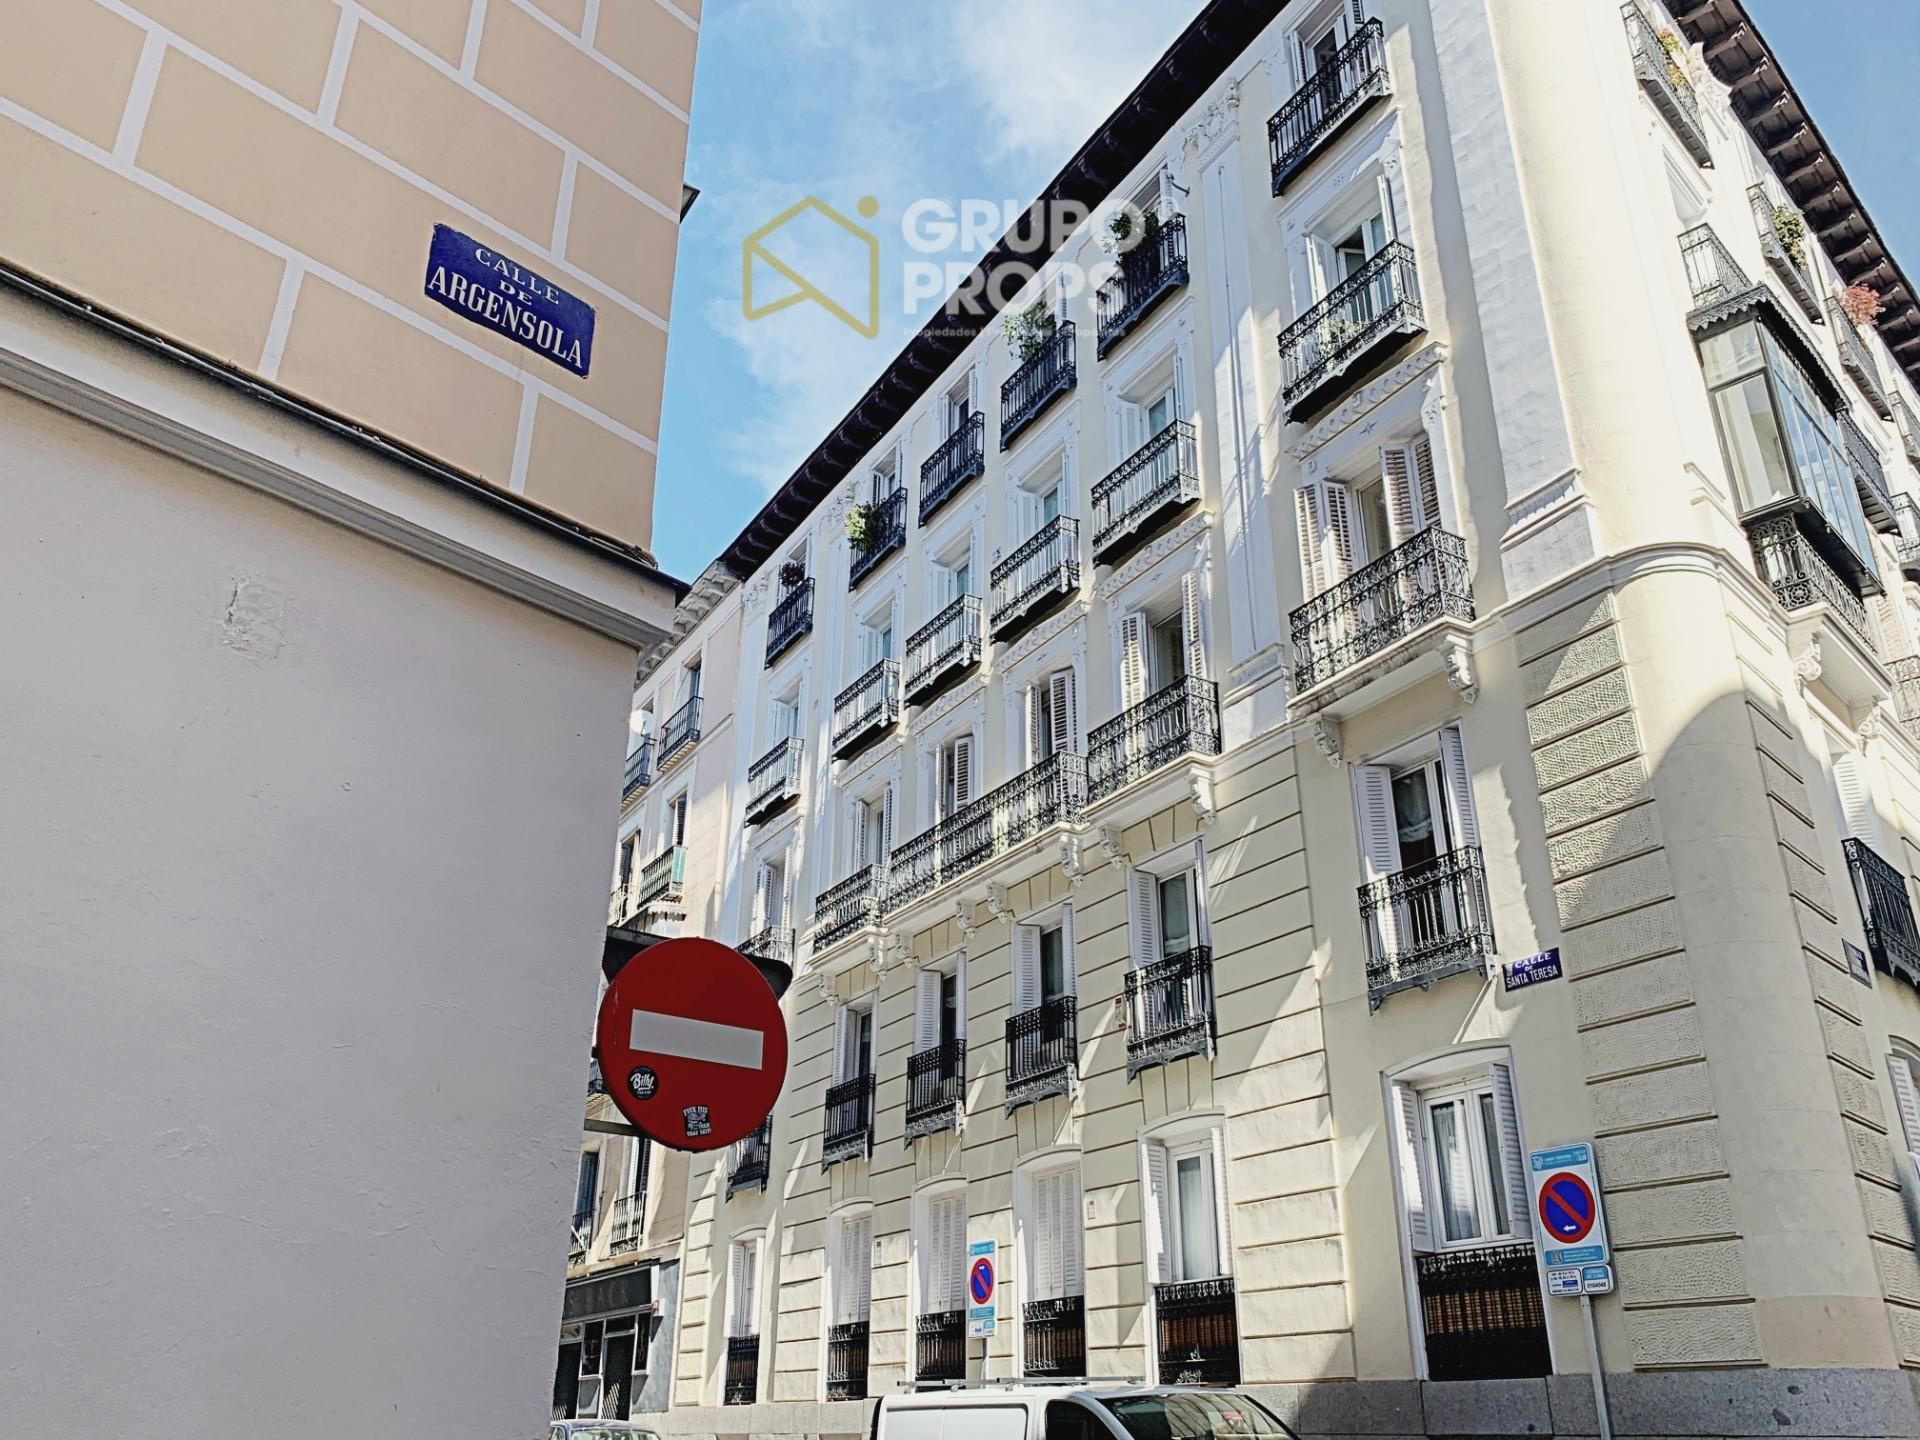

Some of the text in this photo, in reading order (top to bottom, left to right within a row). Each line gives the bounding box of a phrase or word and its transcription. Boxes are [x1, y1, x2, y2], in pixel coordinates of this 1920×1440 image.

[475, 248, 559, 305] CALLE
[498, 279, 532, 306] DE
[427, 265, 583, 369] ARGENSOLA
[1514, 952, 1552, 969] CALLE
[1506, 964, 1559, 988] SANTA TERESA
